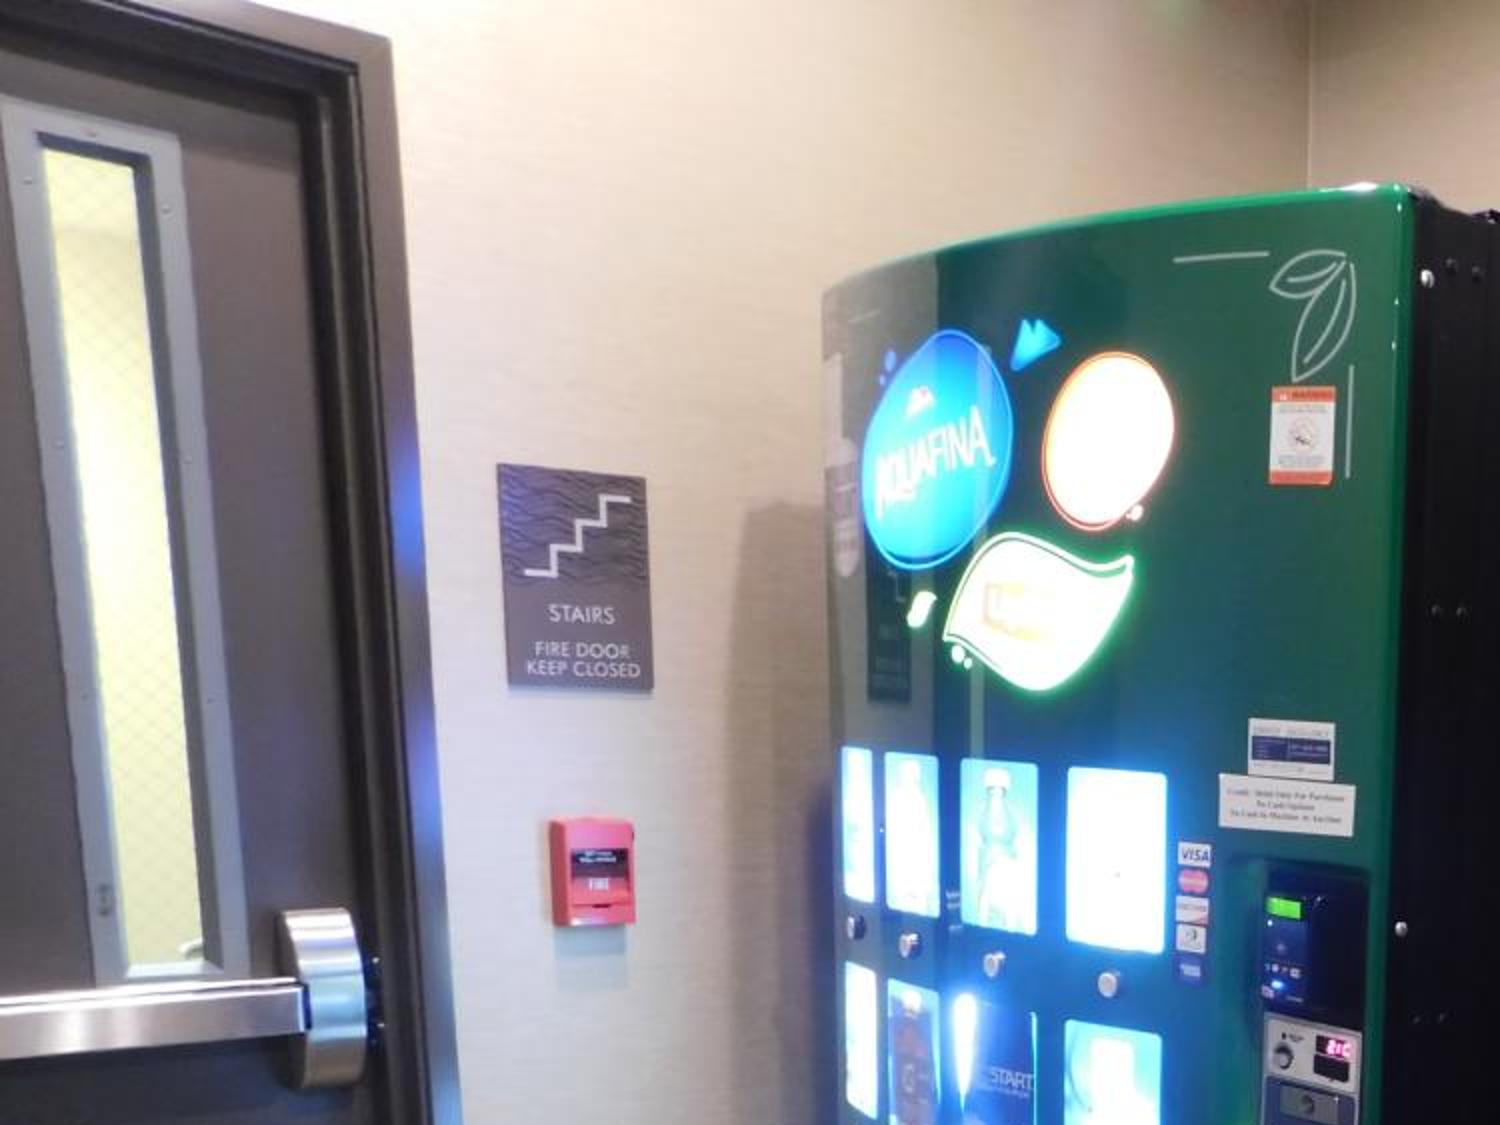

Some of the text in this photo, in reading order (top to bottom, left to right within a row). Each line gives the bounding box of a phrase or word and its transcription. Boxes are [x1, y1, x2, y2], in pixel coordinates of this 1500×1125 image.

[548, 603, 616, 625] STAIRS
[535, 640, 631, 660] FIRE DOOR
[527, 659, 641, 678] KEEP CLOSED
[1182, 848, 1209, 862] VISA
